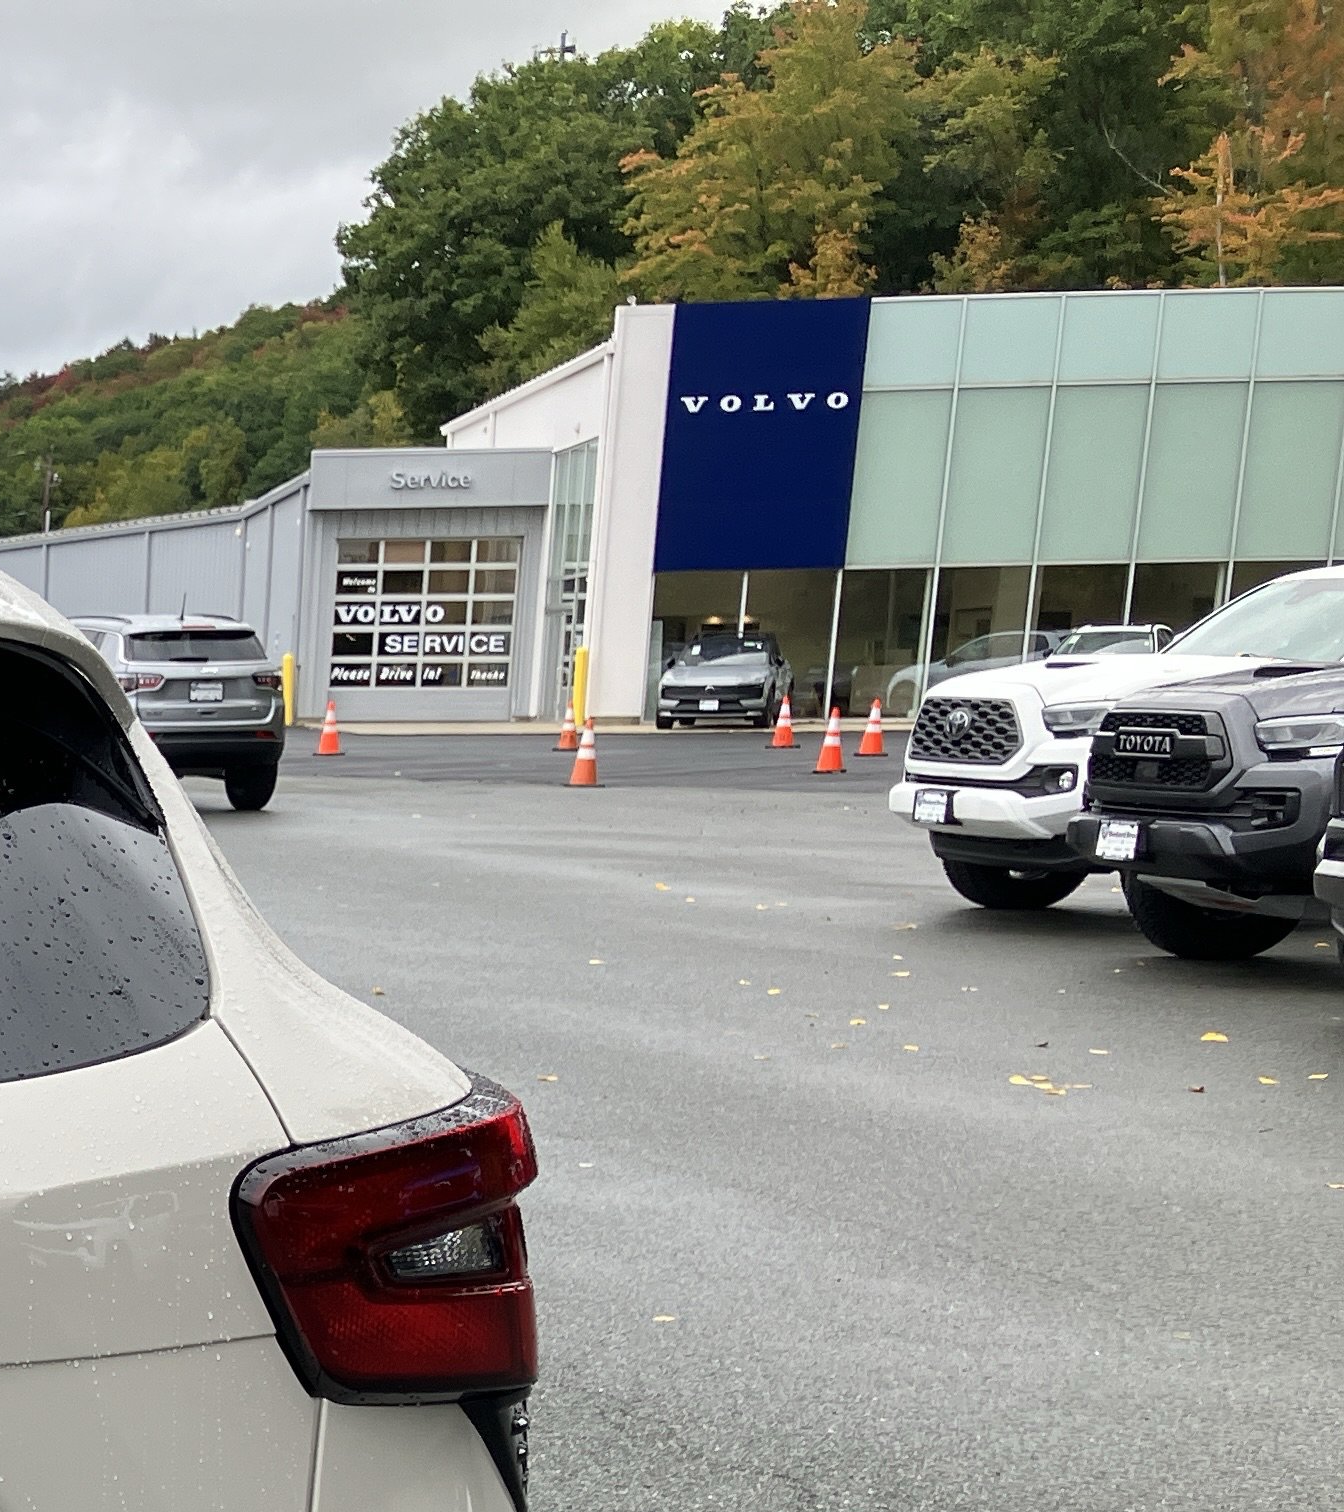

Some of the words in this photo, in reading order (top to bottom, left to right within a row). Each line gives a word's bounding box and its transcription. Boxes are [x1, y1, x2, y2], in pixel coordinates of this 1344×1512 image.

[680, 391, 849, 414] VOLVO
[391, 470, 473, 490] Service
[334, 604, 446, 623] VOLVO
[384, 634, 506, 654] SERVICE
[330, 666, 371, 681] Please
[379, 667, 414, 681] Drive
[1119, 734, 1171, 753] TOYOTA
